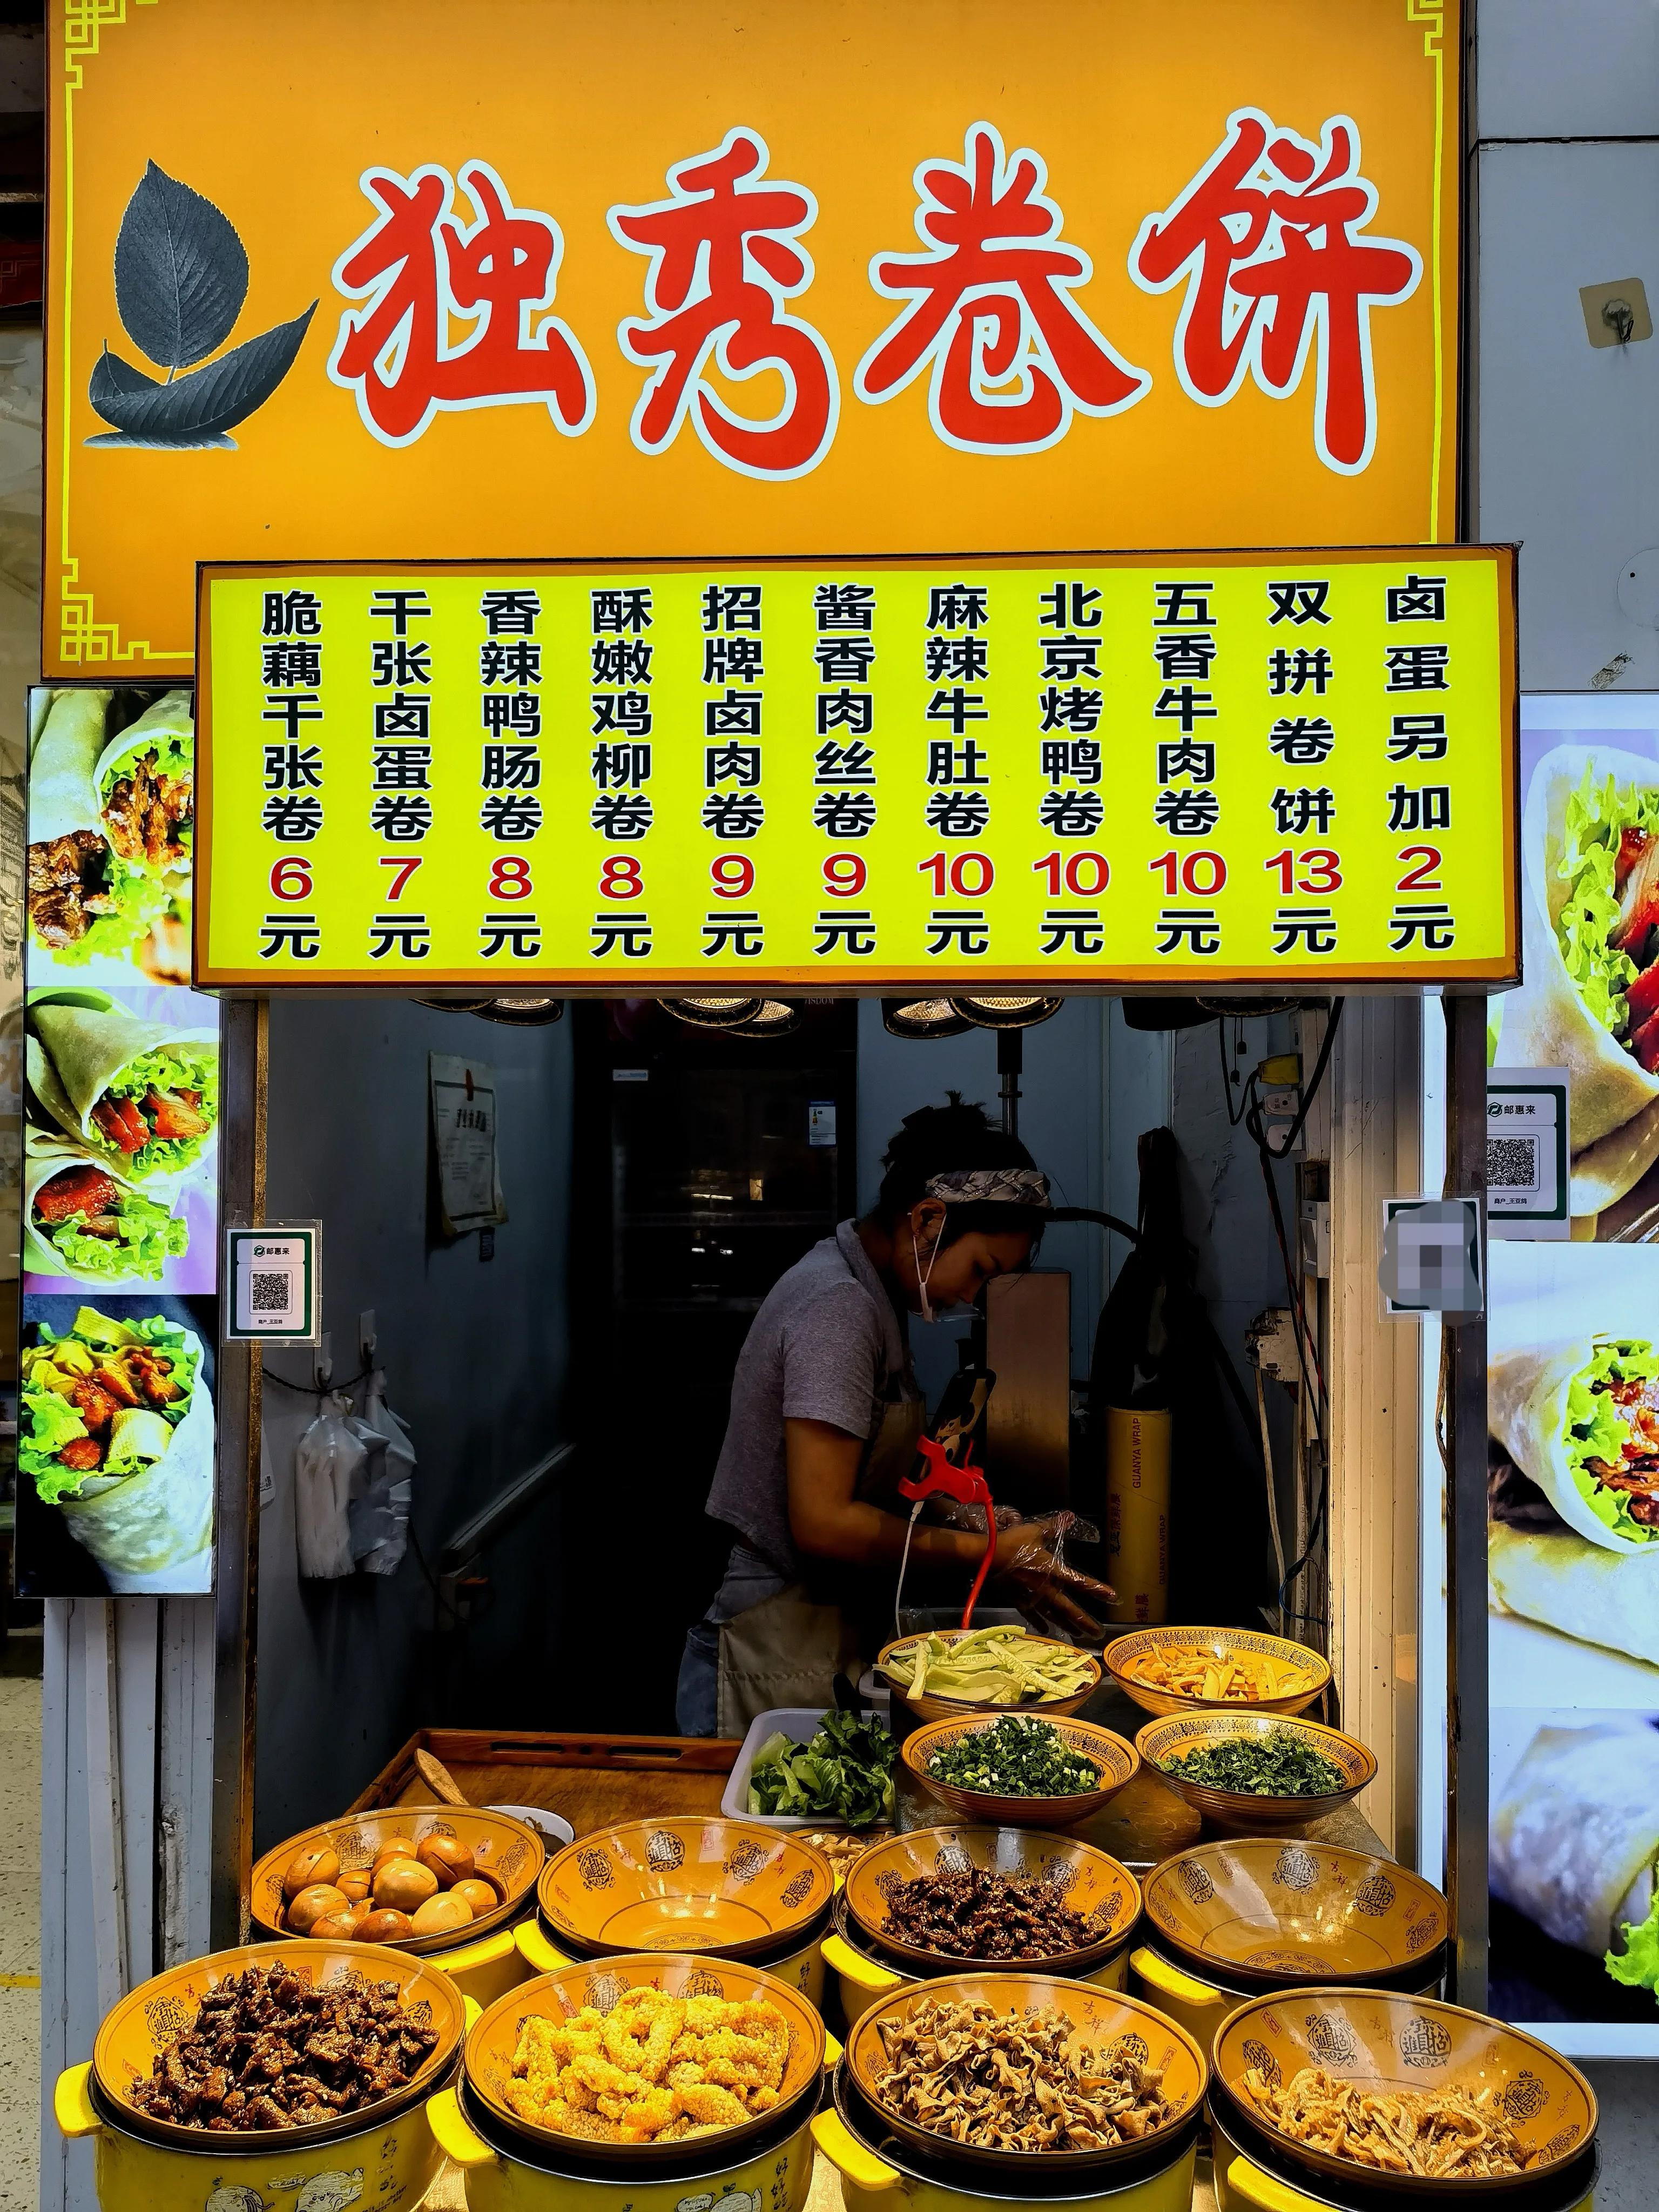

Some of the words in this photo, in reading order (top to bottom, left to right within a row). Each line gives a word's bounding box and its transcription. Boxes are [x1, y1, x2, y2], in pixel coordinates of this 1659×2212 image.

[331, 112, 1417, 476] 独秀卷饼
[1504, 1104, 1536, 1115] 邮惠来
[1132, 1418, 1141, 1446] WRAP
[1132, 1448, 1141, 1488] GUANYA
